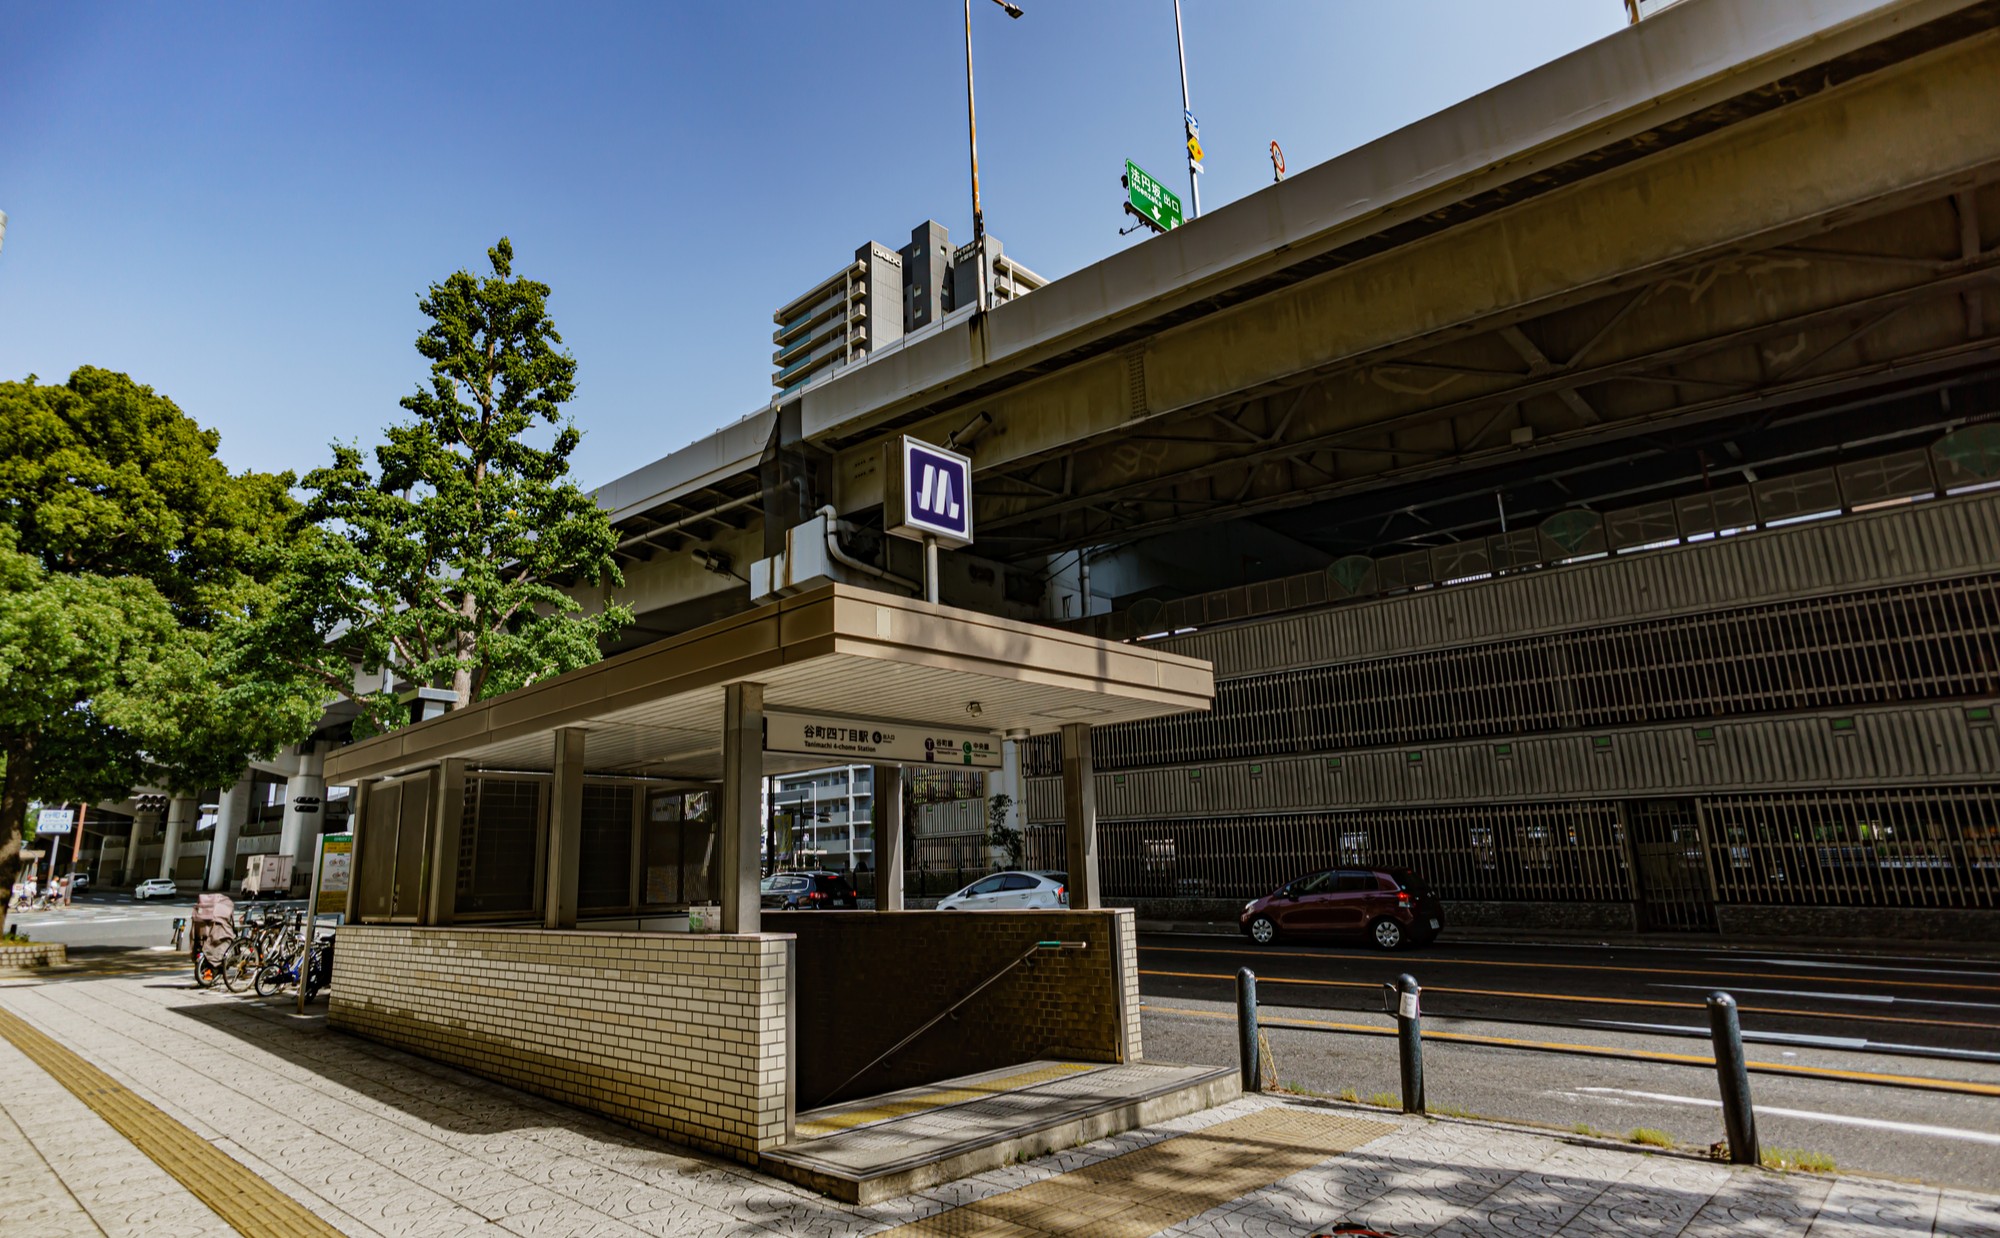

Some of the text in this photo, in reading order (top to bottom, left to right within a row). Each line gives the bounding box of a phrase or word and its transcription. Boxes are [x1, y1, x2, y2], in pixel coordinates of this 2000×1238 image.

[1164, 193, 1180, 213] 出口
[874, 249, 902, 267] DAIDO
[804, 724, 869, 743] 谷町四丁目駅
[804, 741, 876, 753] Tanimachi 4-chome Station
